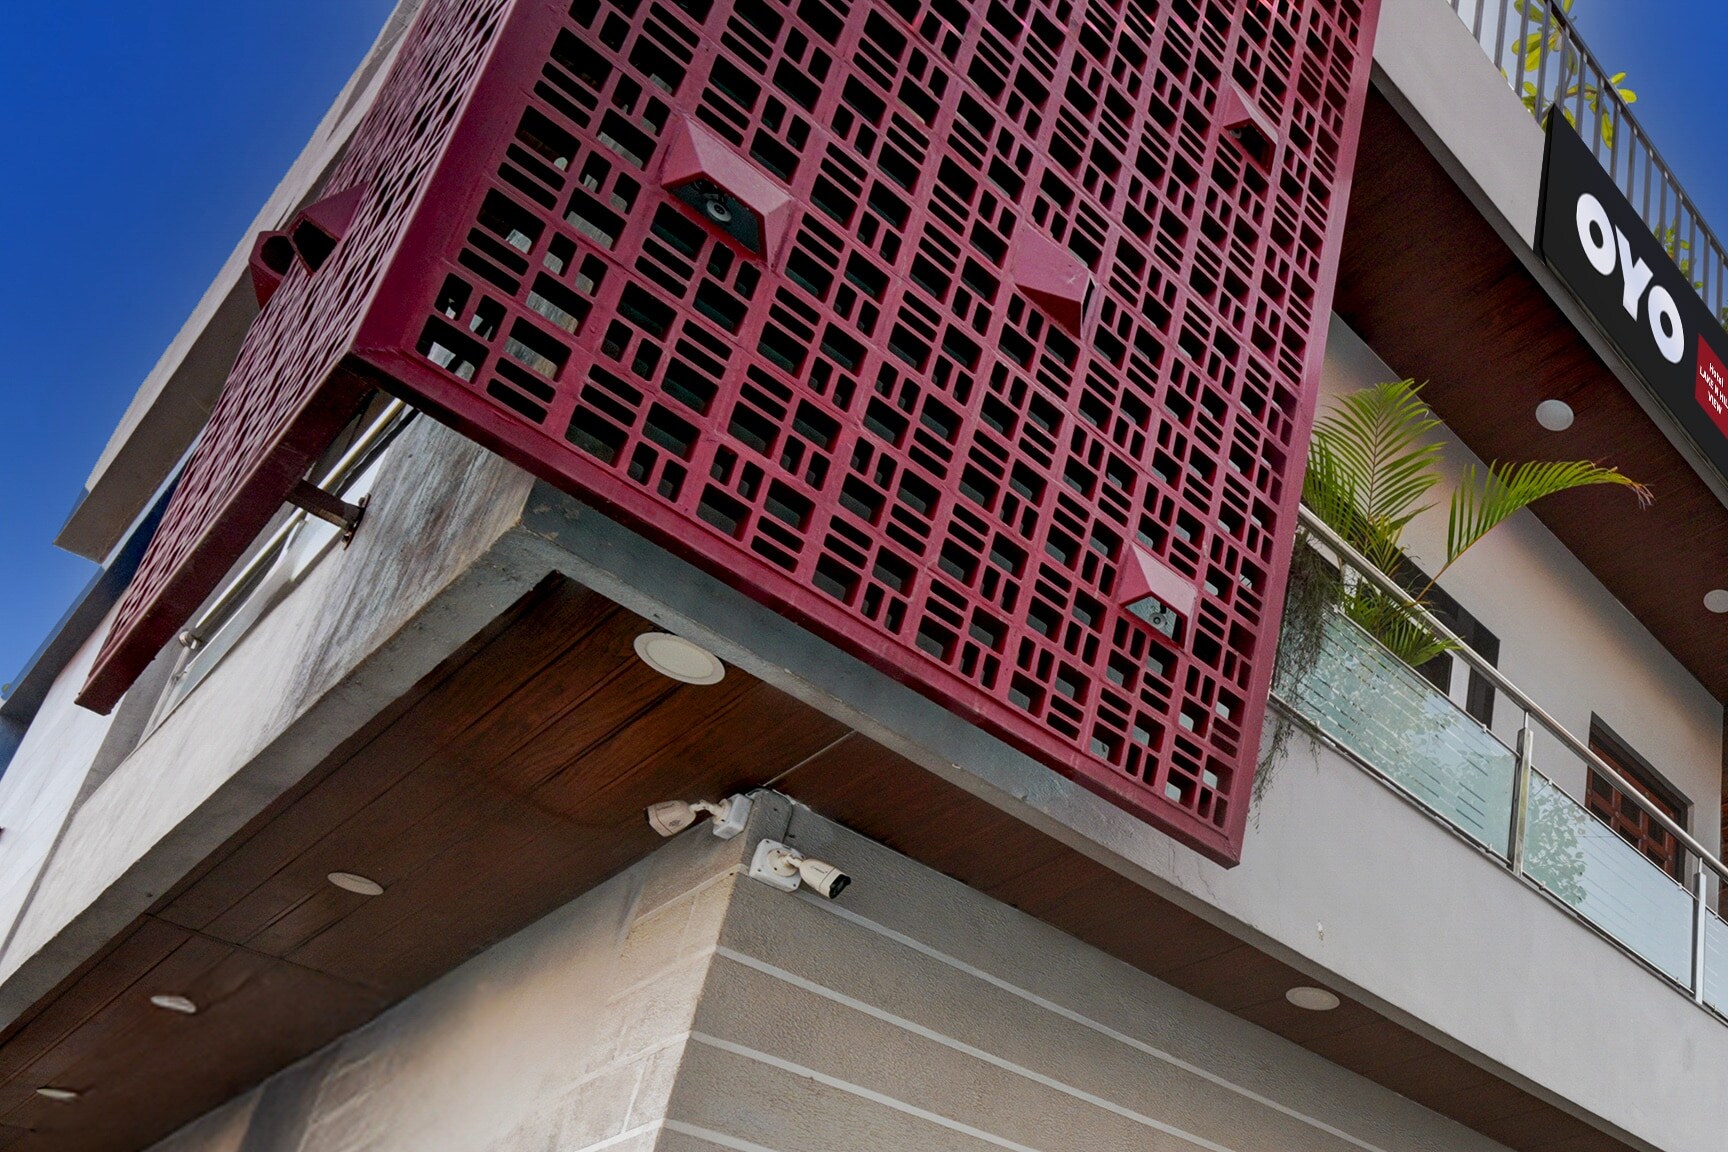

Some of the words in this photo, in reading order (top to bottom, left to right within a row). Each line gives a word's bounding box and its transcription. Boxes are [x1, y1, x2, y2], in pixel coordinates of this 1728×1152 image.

[1575, 192, 1685, 364] OYO
[1699, 365, 1714, 390] LAKE
[1709, 362, 1724, 388] Hotel
[1707, 390, 1723, 414] VIEW
